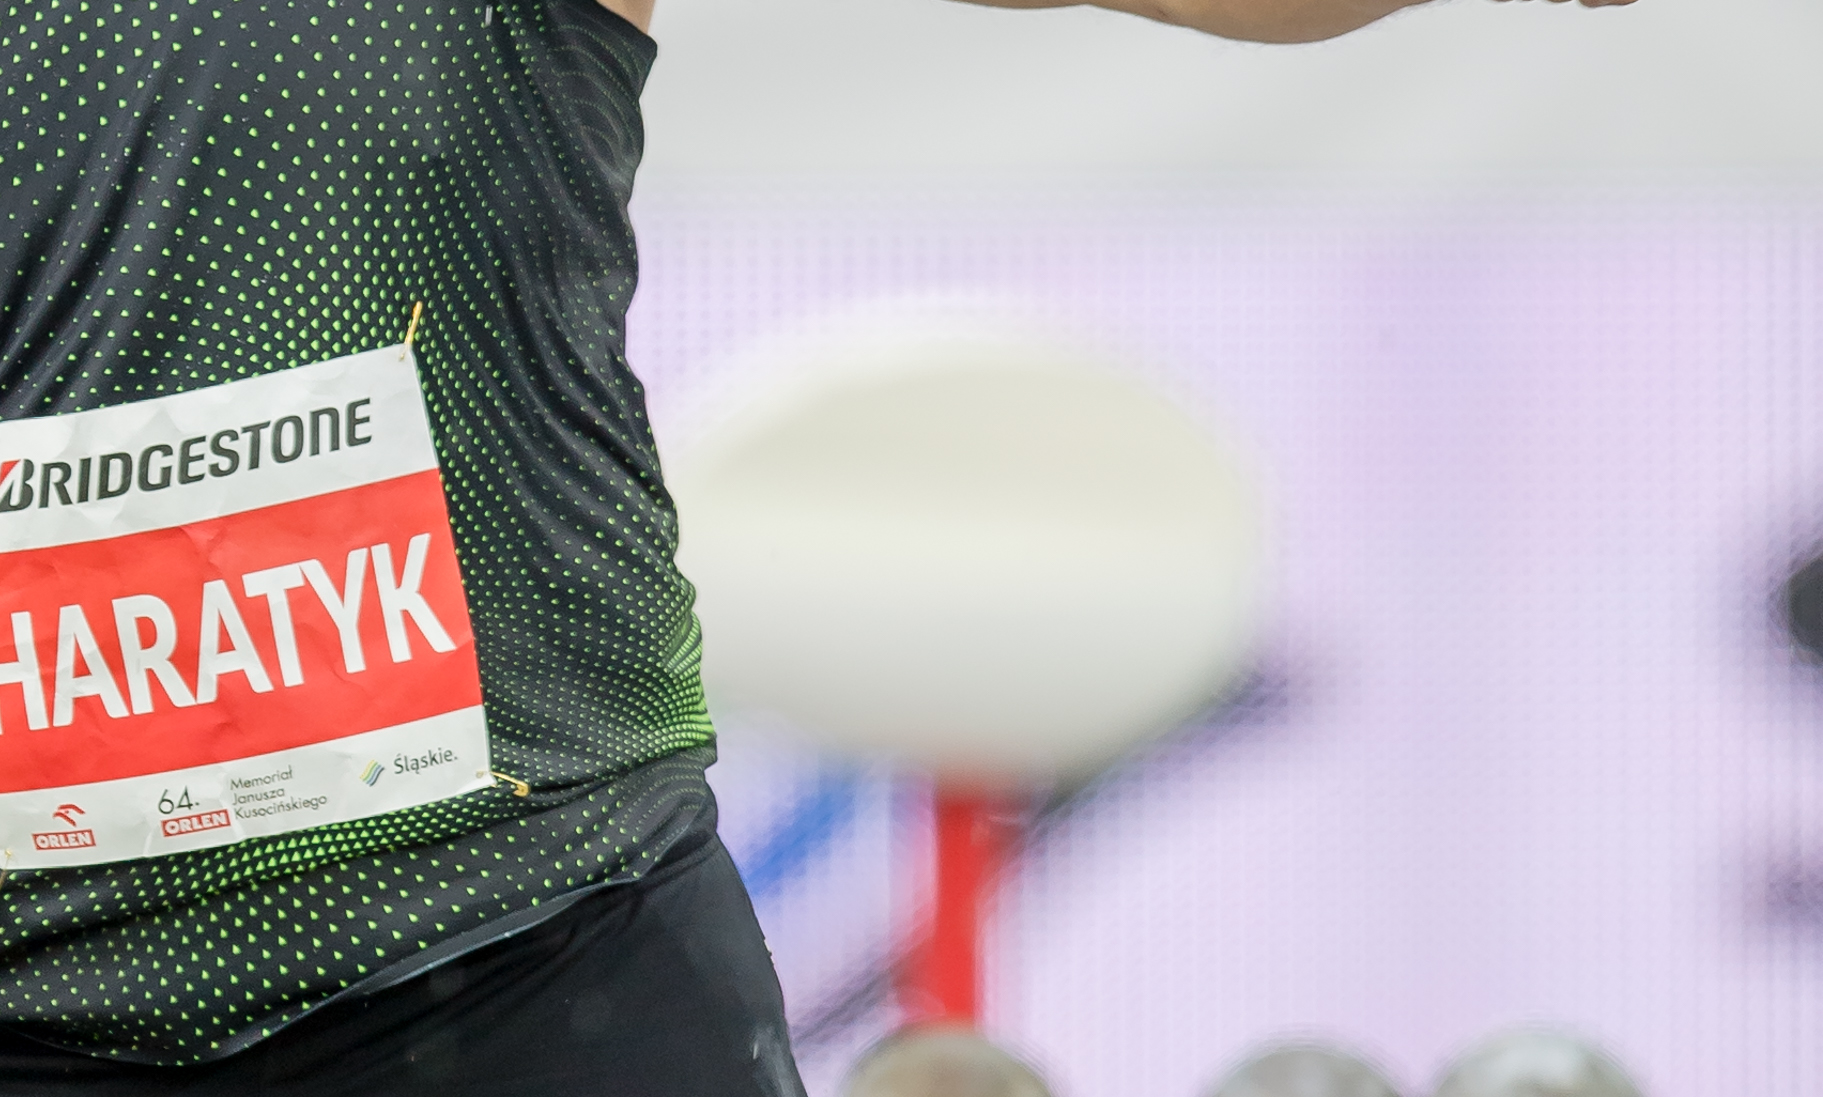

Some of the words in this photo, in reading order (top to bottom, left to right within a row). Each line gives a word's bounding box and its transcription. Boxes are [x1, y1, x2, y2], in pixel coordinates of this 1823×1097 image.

[230, 765, 293, 790] Memoriał
[232, 787, 285, 805] Janusza
[234, 794, 328, 820] Kusocińskiego
[164, 811, 228, 835] ORLEN
[35, 831, 92, 849] ORLEN
